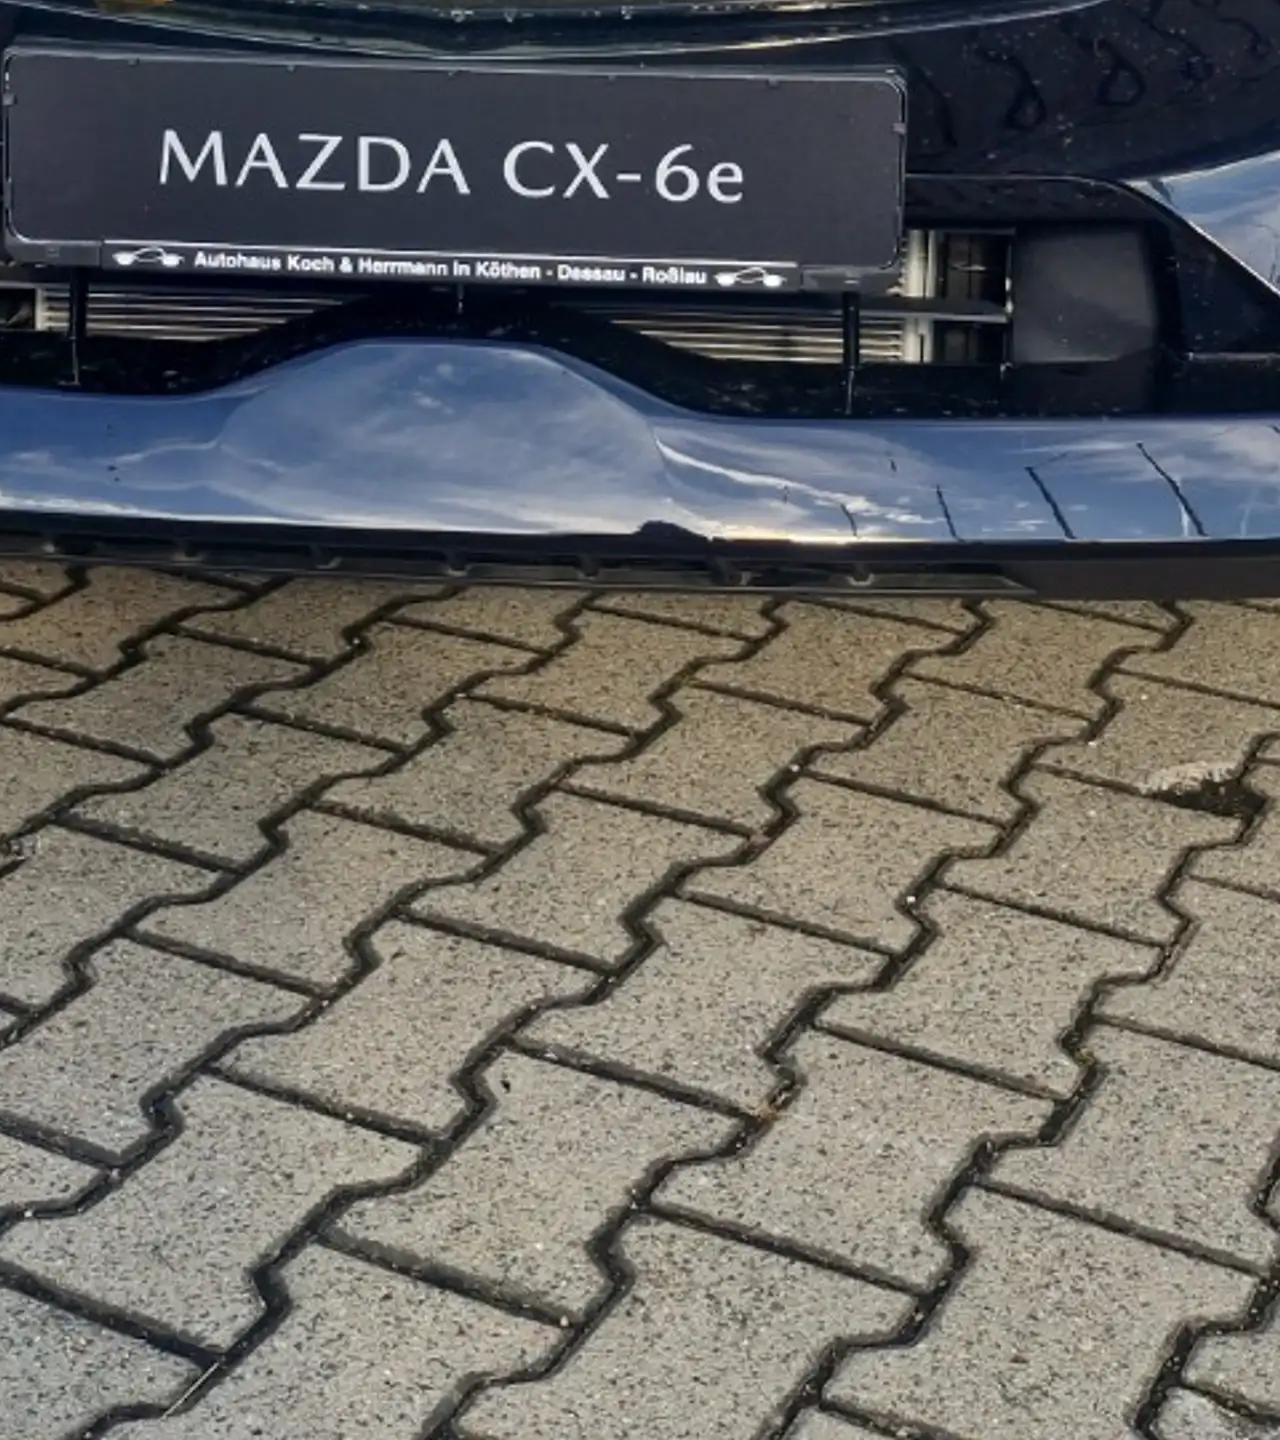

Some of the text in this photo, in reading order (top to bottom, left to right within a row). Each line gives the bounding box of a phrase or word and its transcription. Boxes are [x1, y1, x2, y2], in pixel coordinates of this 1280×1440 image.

[159, 129, 744, 203] MAZDA CX-6e
[194, 251, 281, 271] Autohaus
[287, 254, 335, 273] Koch
[339, 257, 352, 273] &
[358, 257, 447, 277] Herrmann
[475, 261, 541, 280] Köthen
[557, 264, 626, 283] Dessau
[643, 266, 707, 285] Roßlau
